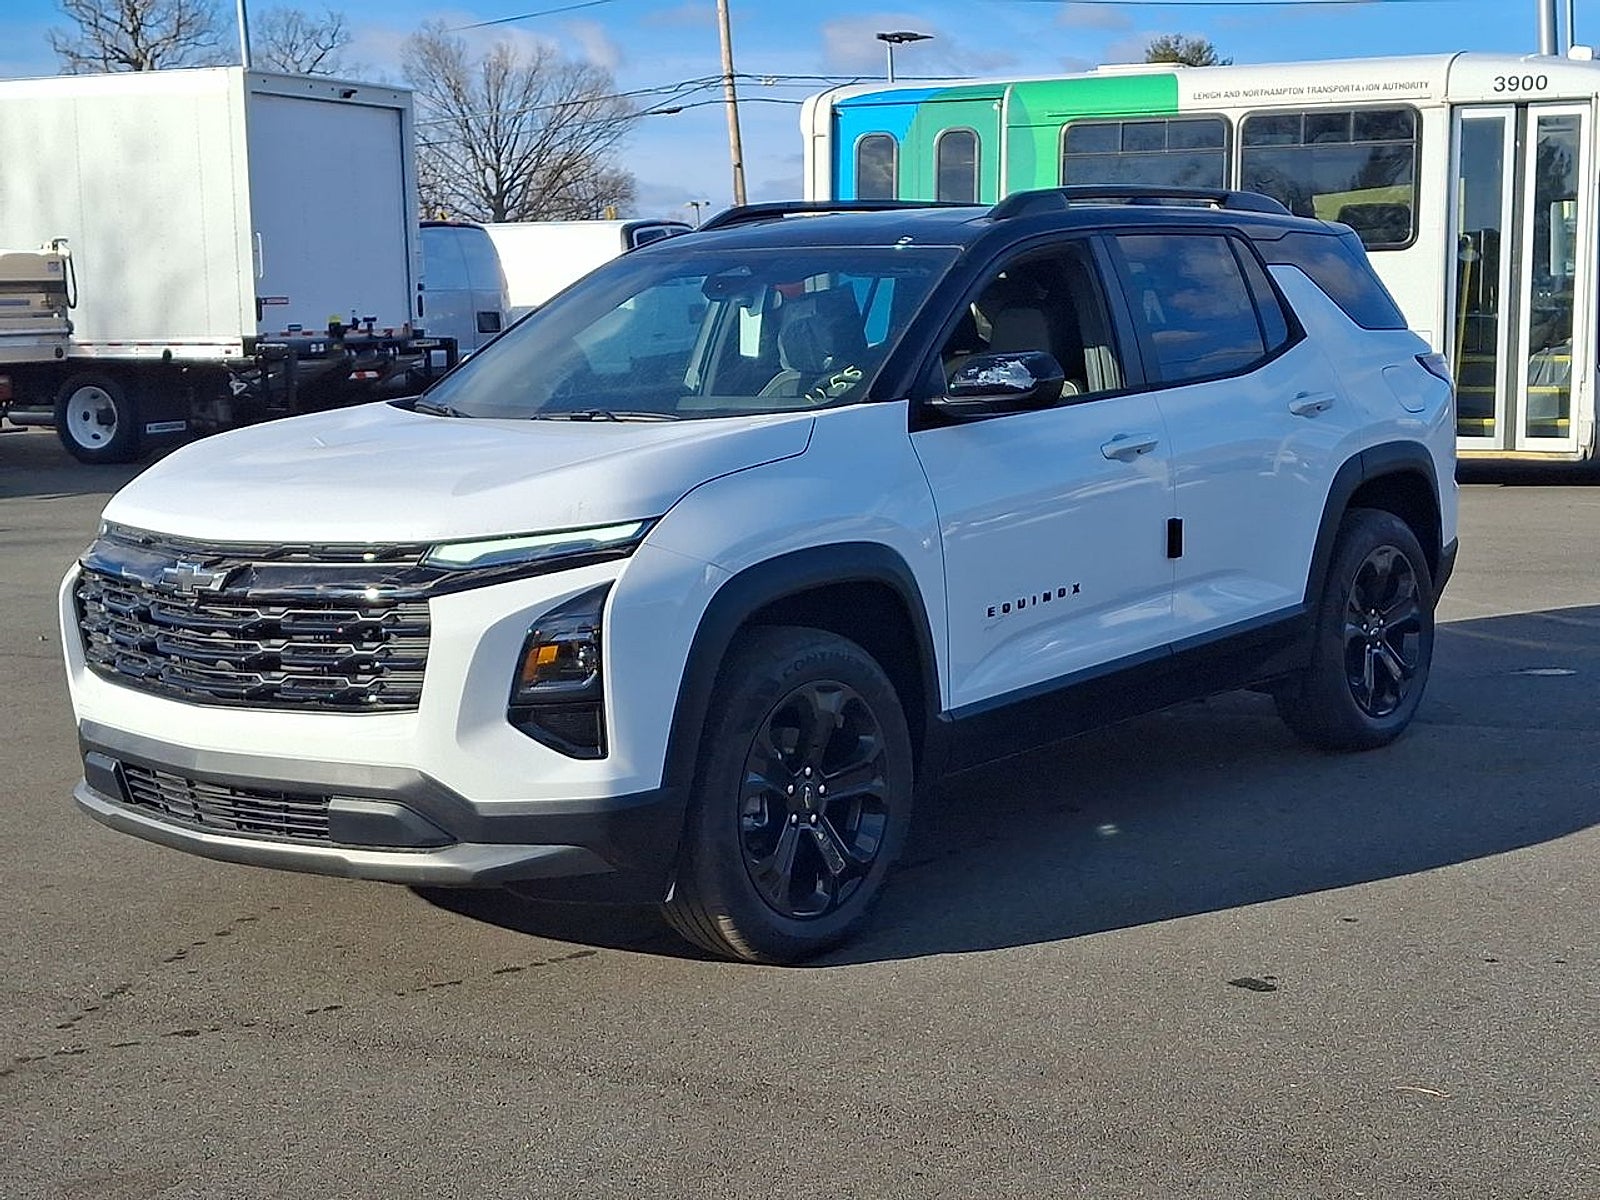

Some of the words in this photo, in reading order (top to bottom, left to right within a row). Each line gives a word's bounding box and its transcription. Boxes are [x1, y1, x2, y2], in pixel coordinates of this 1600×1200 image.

[1193, 91, 1222, 100] LEHIGH
[1223, 90, 1240, 98] AND
[1242, 87, 1304, 97] NORTHAMPTON
[1382, 81, 1429, 91] AUTHORITY
[1493, 75, 1548, 92] 3900
[987, 583, 1080, 617] EQUINOX
